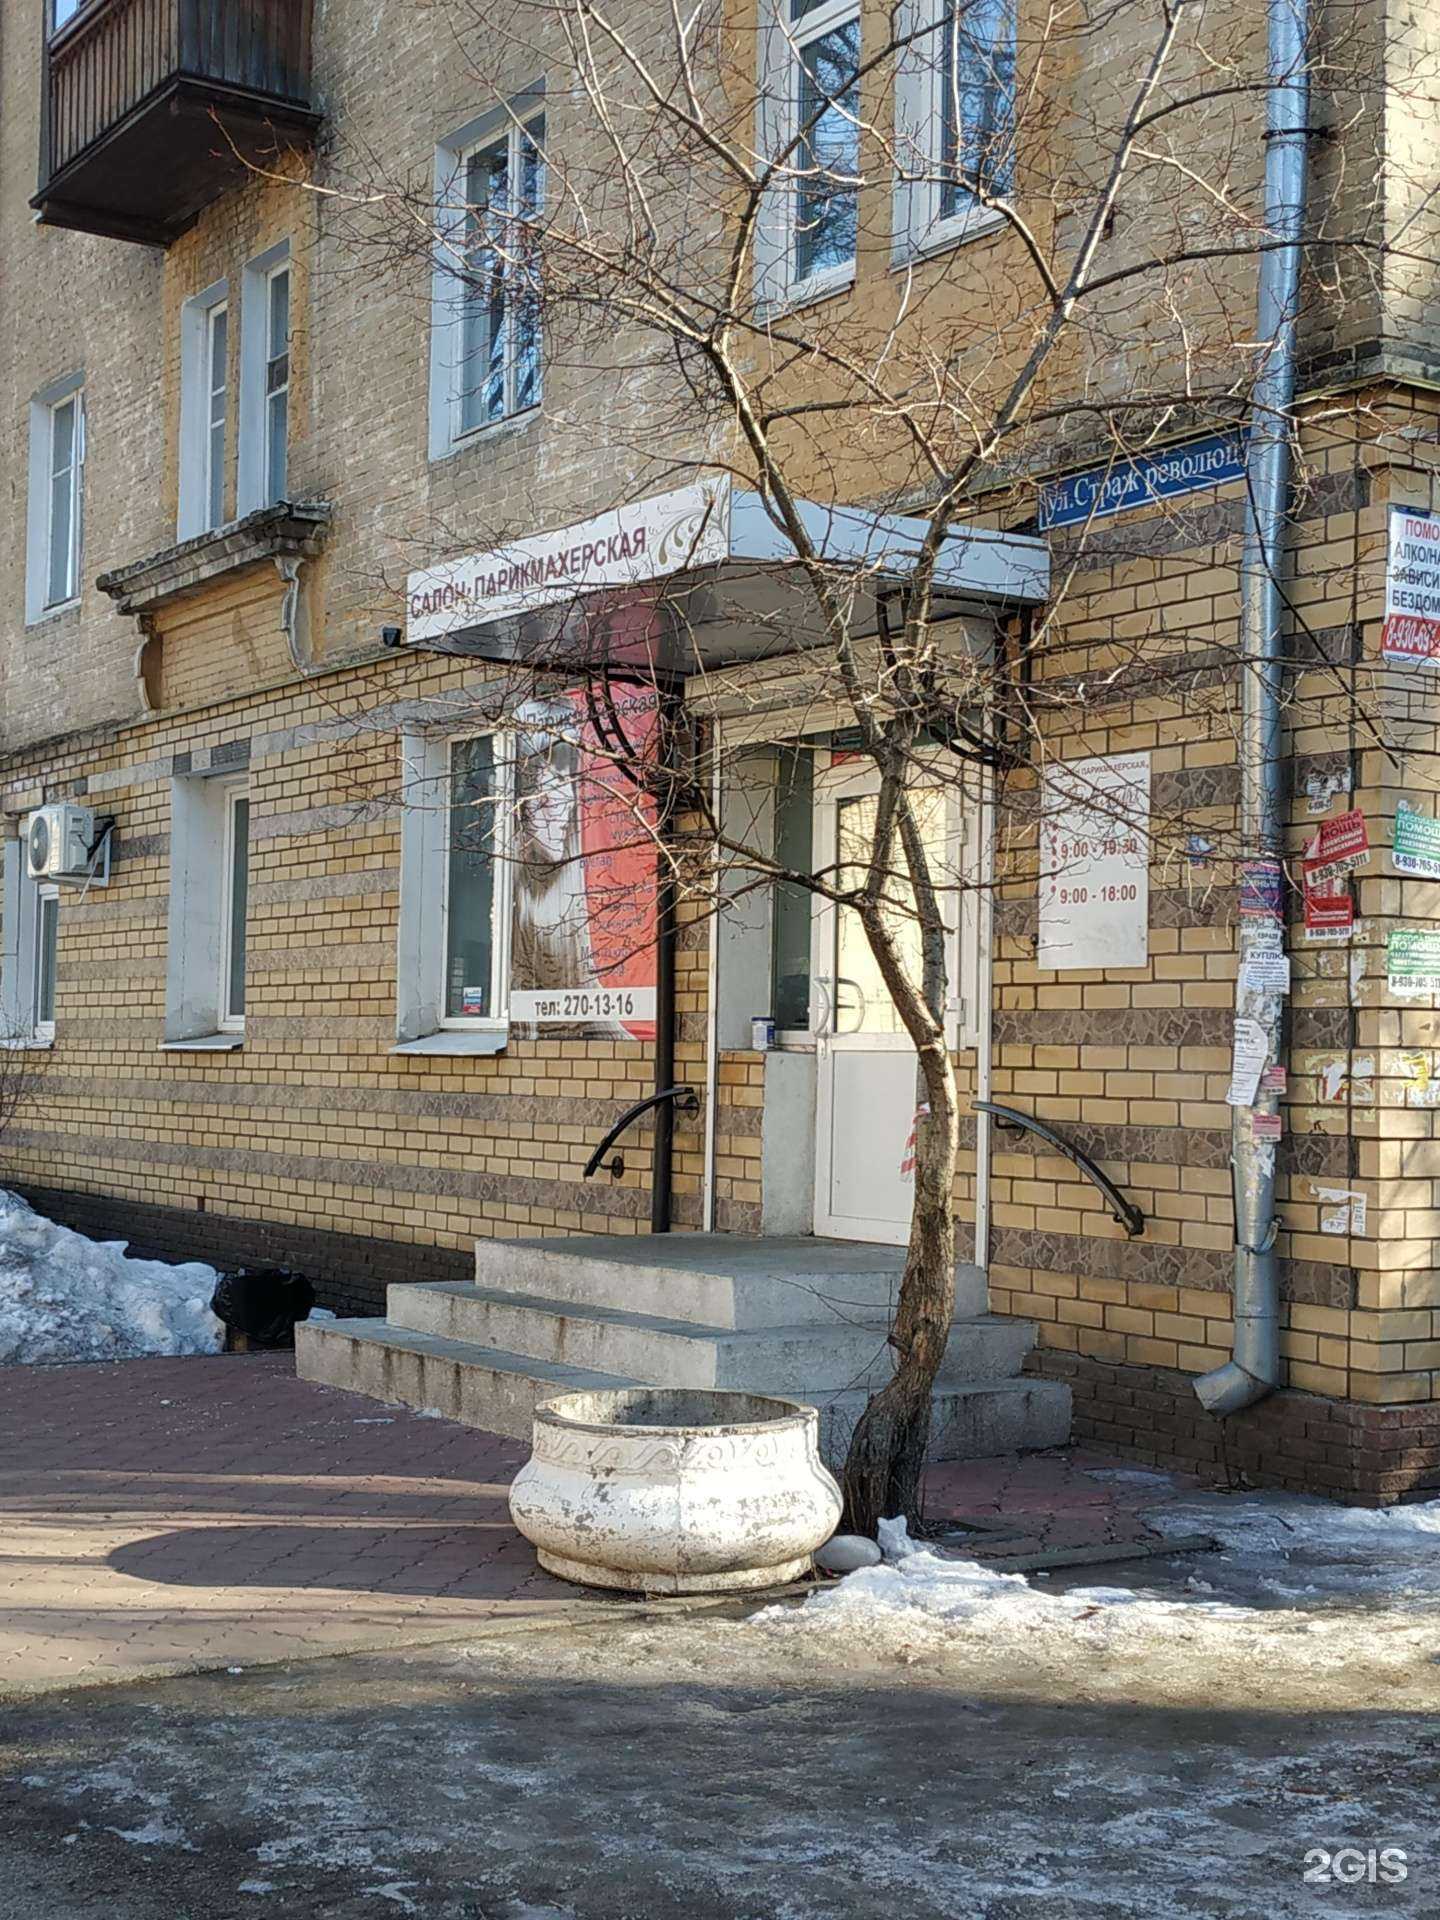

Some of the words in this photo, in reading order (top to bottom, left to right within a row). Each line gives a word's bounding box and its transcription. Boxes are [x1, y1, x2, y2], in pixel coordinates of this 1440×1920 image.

[1061, 842, 1089, 859] 9:00
[1060, 887, 1088, 904] 9:00
[1101, 885, 1137, 902] 18:00
[534, 1000, 560, 1017] тел:
[564, 993, 634, 1016] 270-13-16
